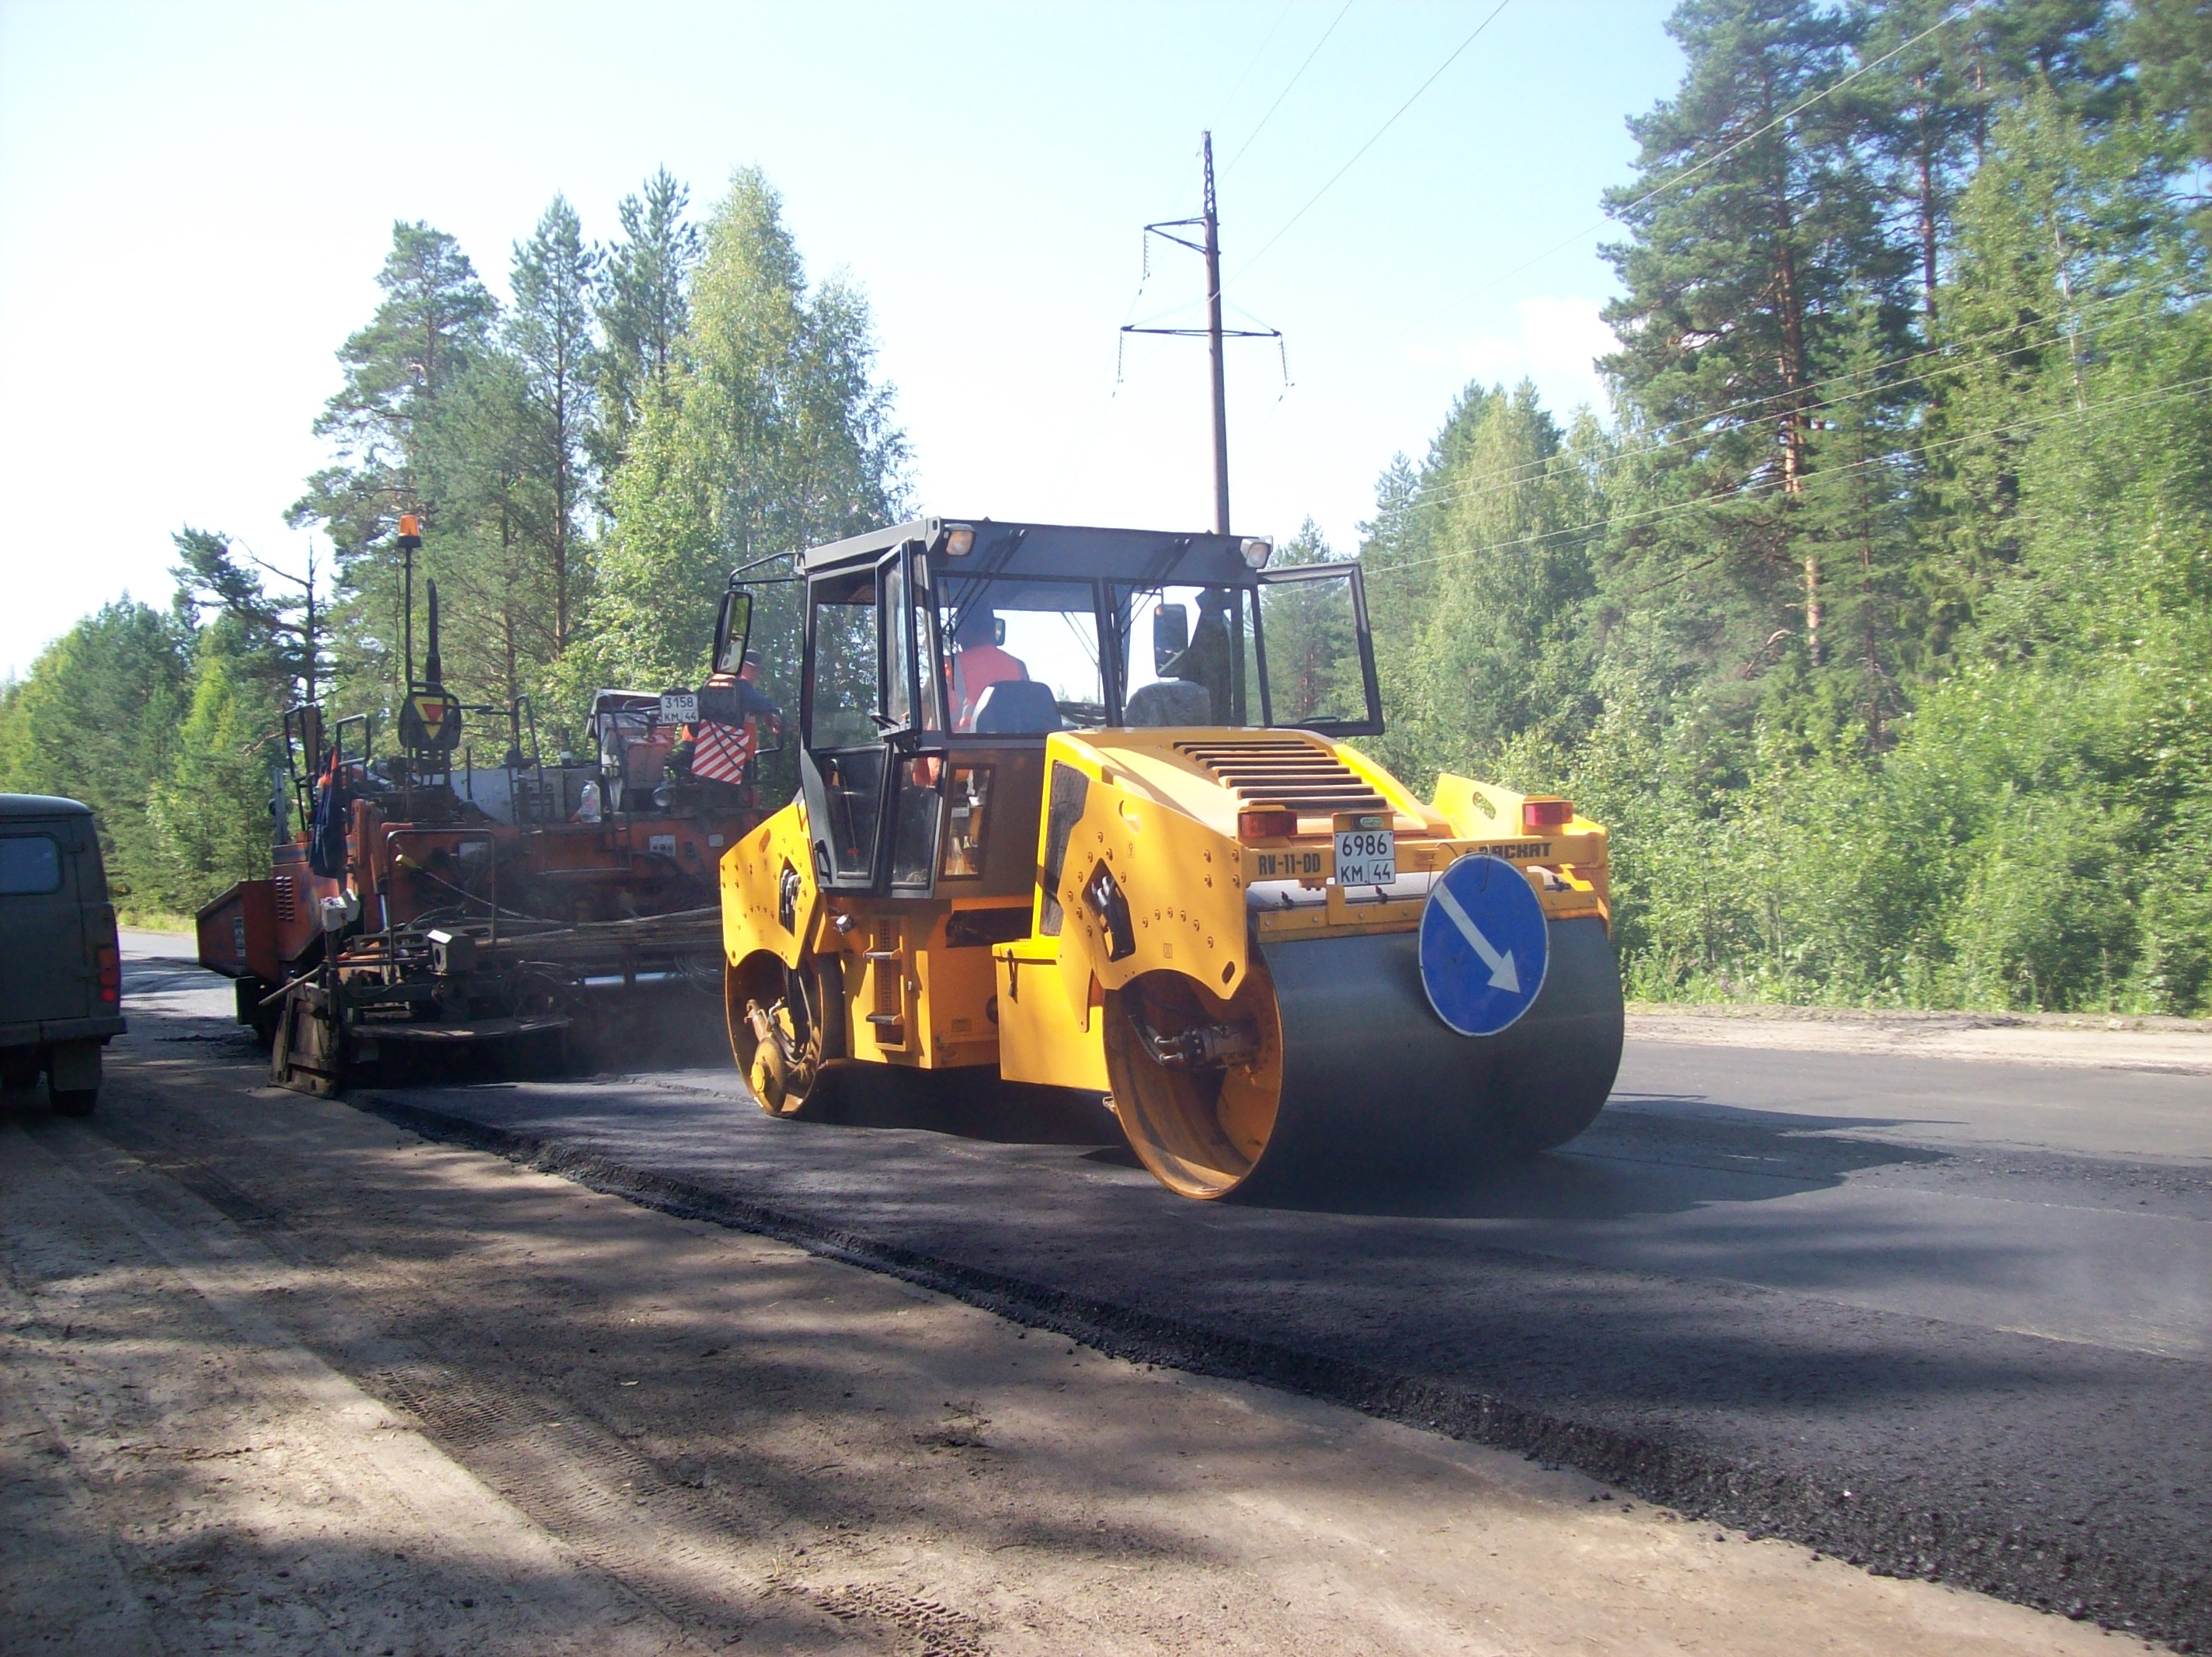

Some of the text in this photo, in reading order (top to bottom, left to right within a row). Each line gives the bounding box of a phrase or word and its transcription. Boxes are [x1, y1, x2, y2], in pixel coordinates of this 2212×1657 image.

[665, 696, 694, 708] 3158
[684, 711, 696, 721] 44
[1342, 834, 1387, 856] 6986
[1373, 863, 1390, 881] 44
